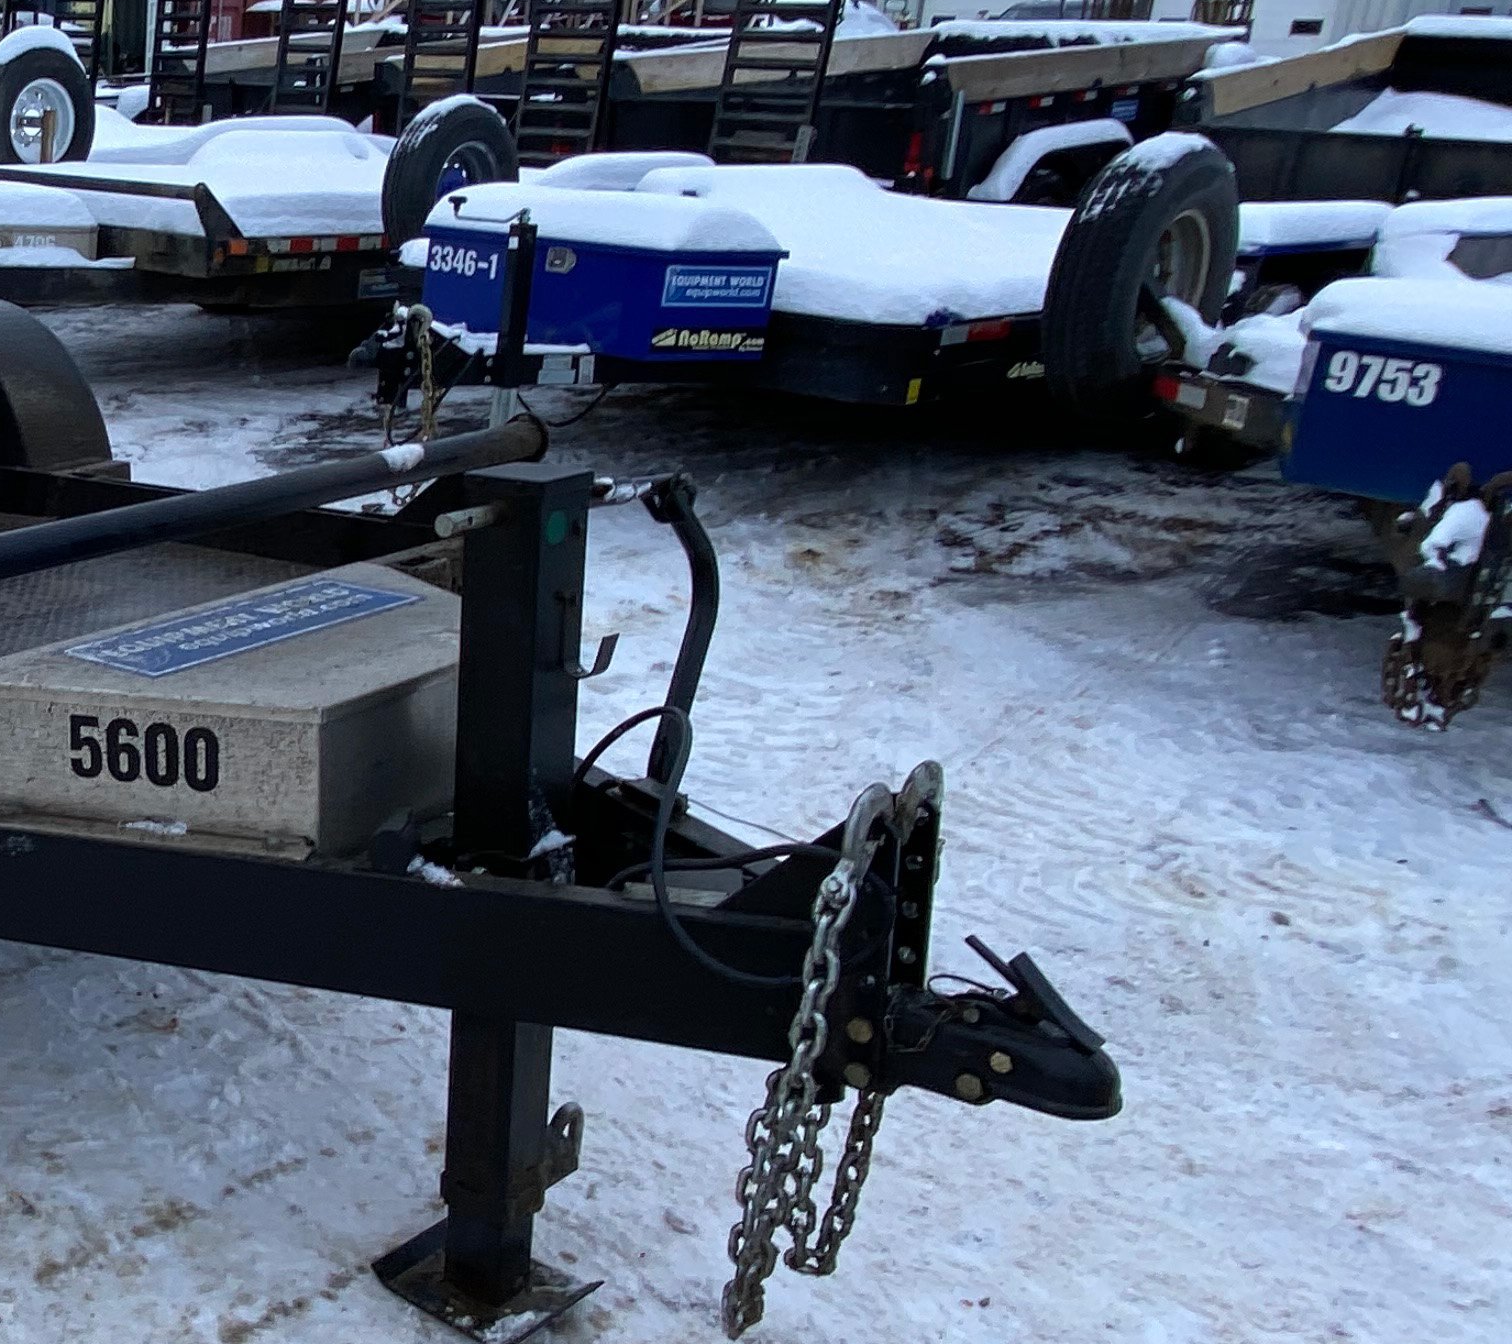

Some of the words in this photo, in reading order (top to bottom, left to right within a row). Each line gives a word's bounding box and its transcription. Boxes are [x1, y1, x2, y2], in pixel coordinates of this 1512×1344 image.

[430, 245, 499, 280] 3346-1
[729, 276, 765, 288] WORLD
[1324, 350, 1443, 407] 9753
[70, 714, 220, 792] 5600
